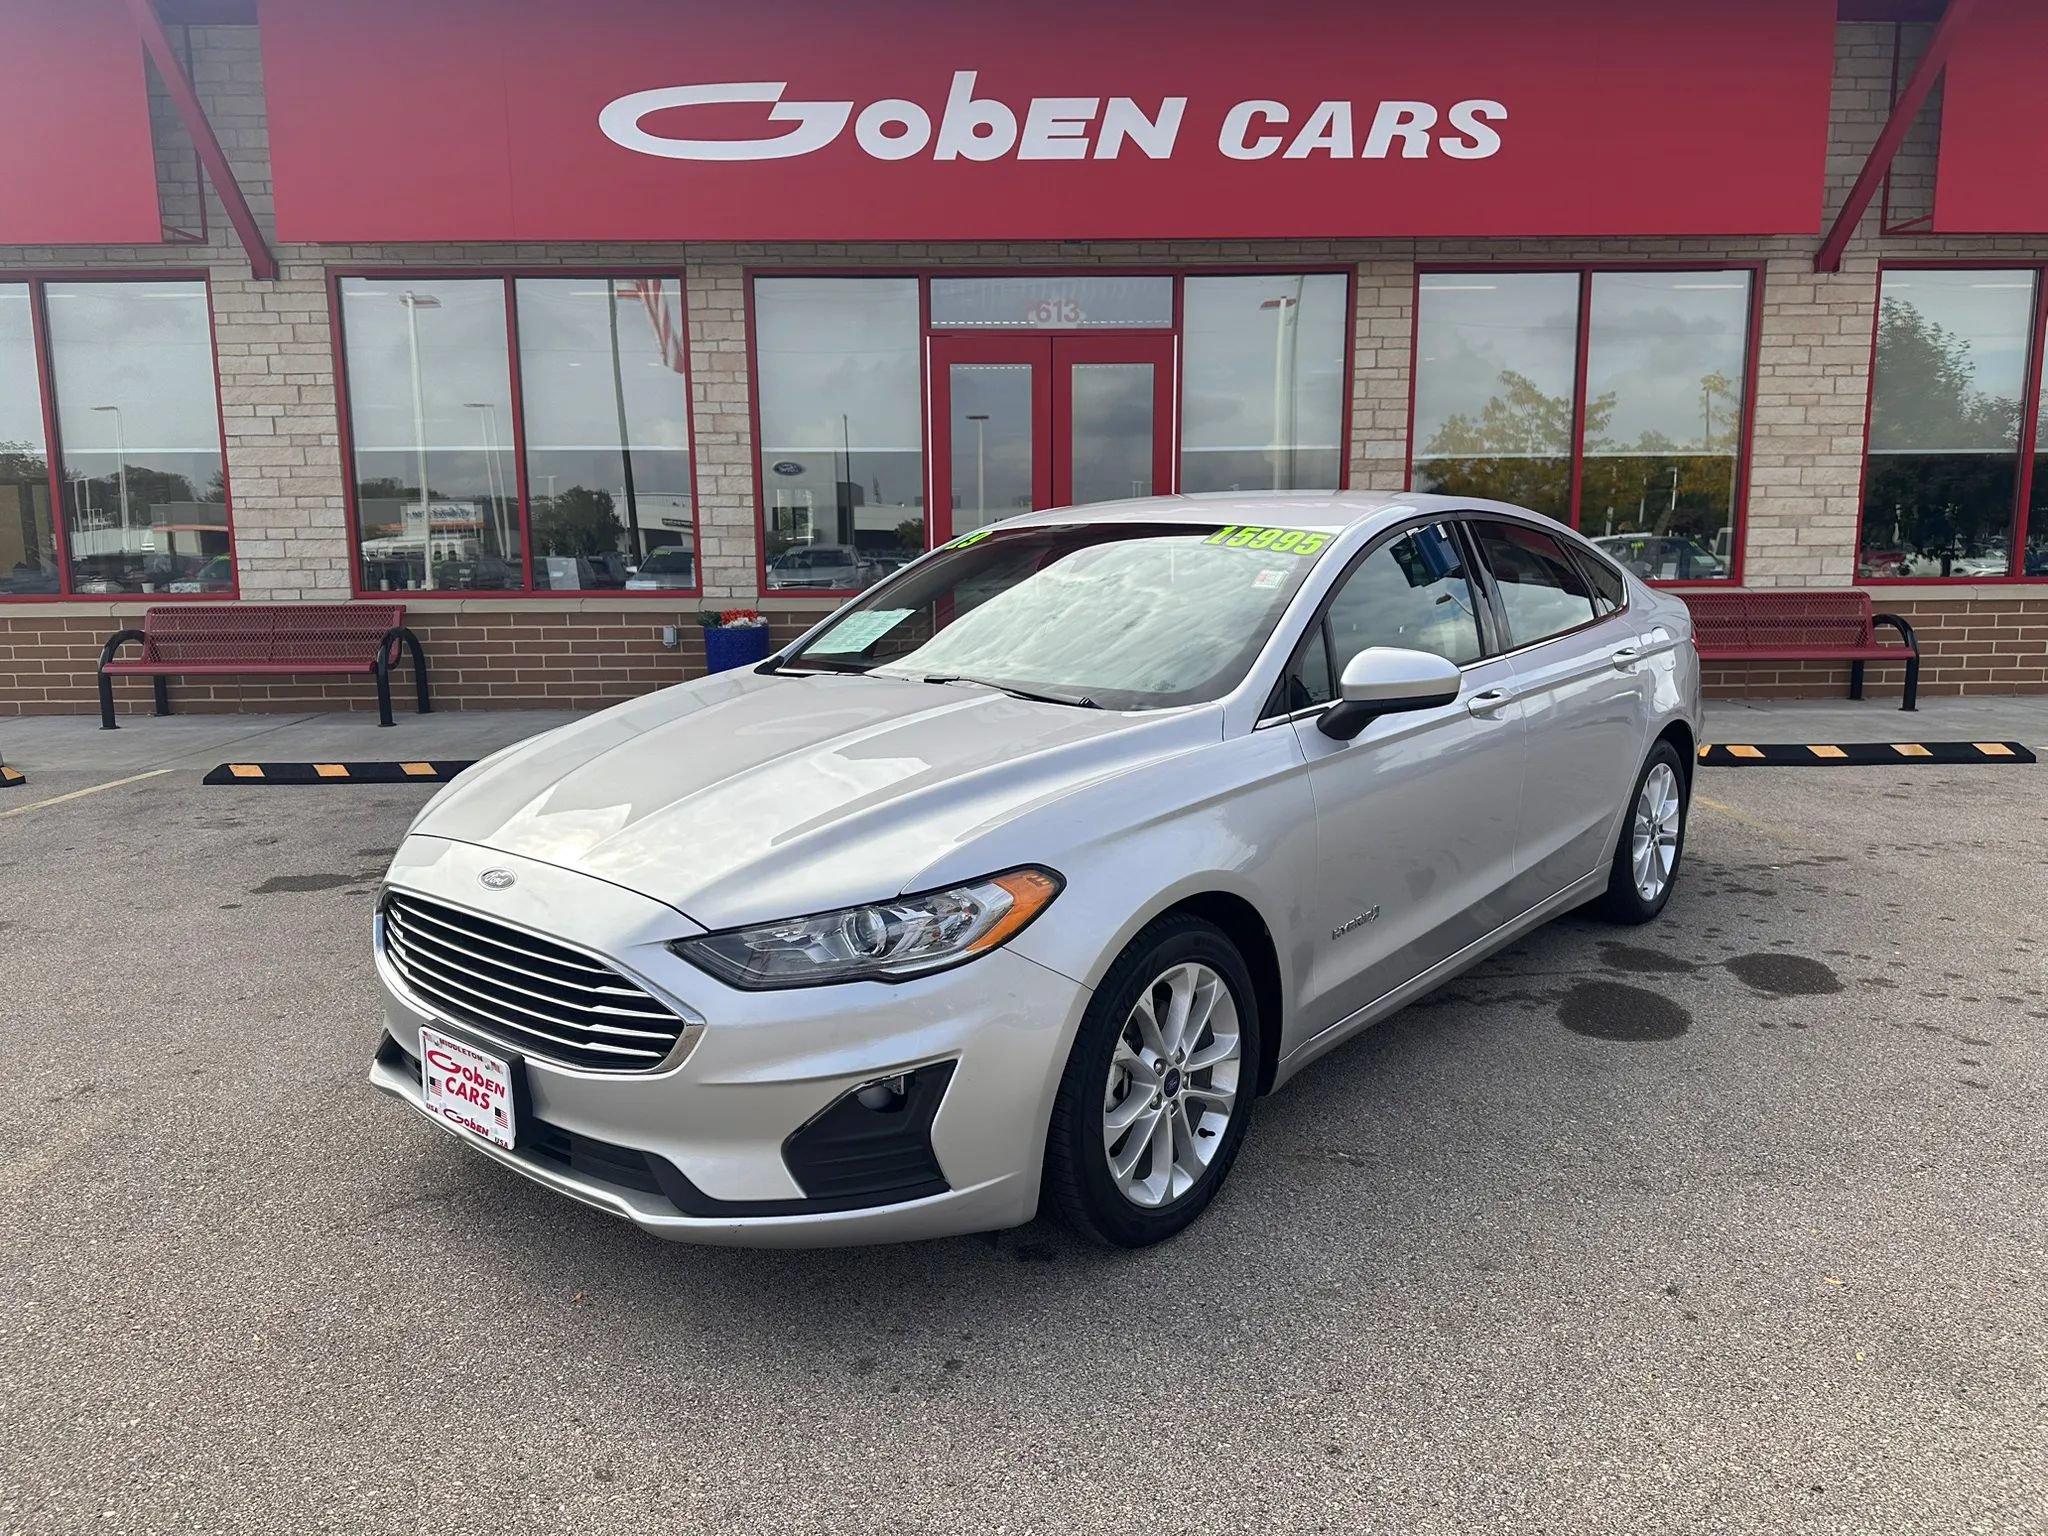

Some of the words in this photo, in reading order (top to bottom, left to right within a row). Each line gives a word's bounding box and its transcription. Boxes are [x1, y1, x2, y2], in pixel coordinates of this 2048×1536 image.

[1218, 100, 1508, 160] CARS
[1203, 525, 1332, 555] 15995
[439, 1038, 484, 1062] MIDDLETON
[445, 1077, 490, 1110] CARS
[426, 1103, 438, 1114] USA
[494, 1137, 509, 1148] USA
